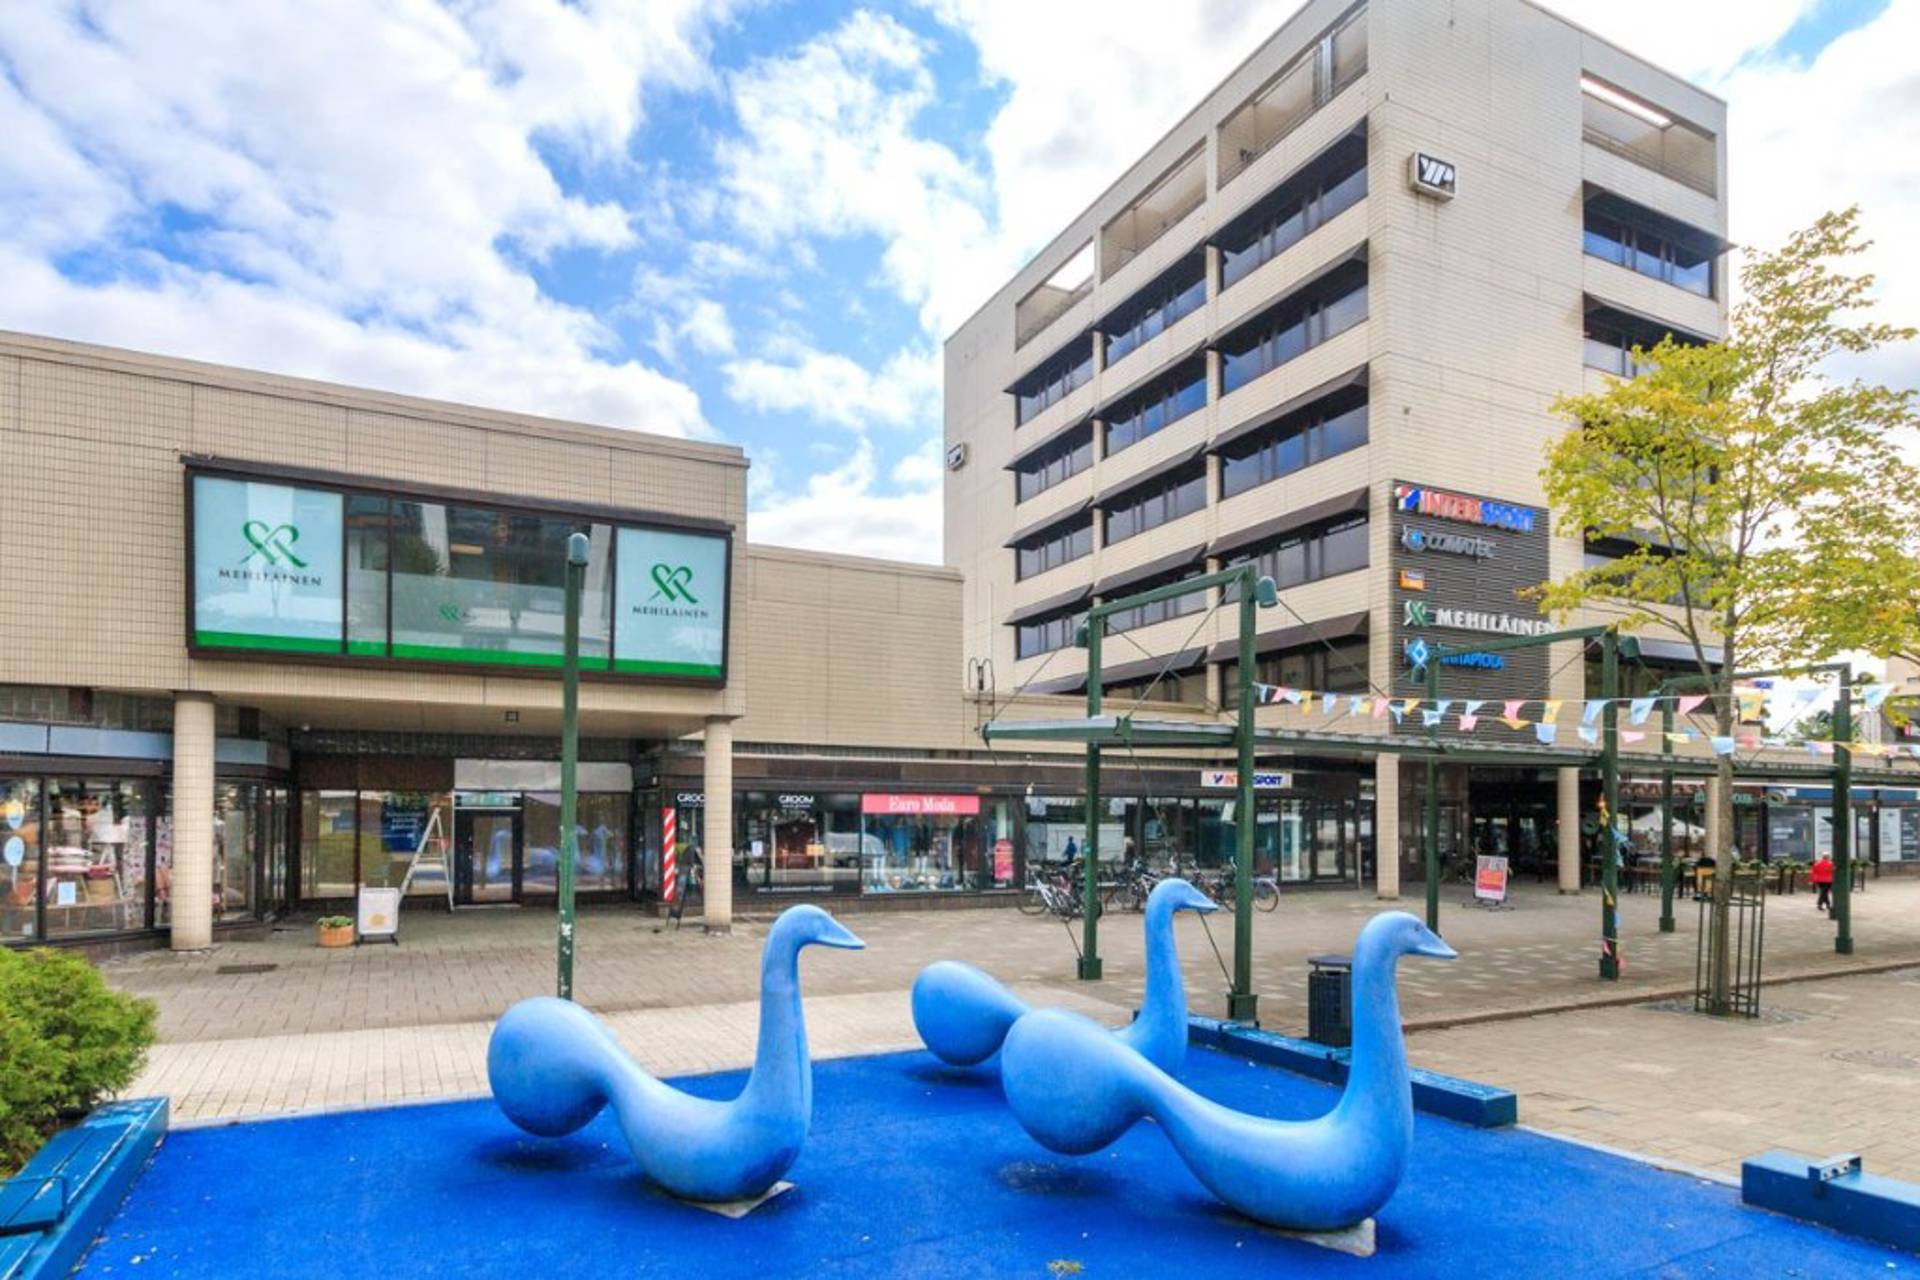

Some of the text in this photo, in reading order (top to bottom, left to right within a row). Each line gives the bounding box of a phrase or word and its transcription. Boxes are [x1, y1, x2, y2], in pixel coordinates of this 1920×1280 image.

[1418, 491, 1534, 532] INTERSPORT
[1435, 608, 1558, 637] MEHILÄINEN
[888, 794, 921, 812] Euro
